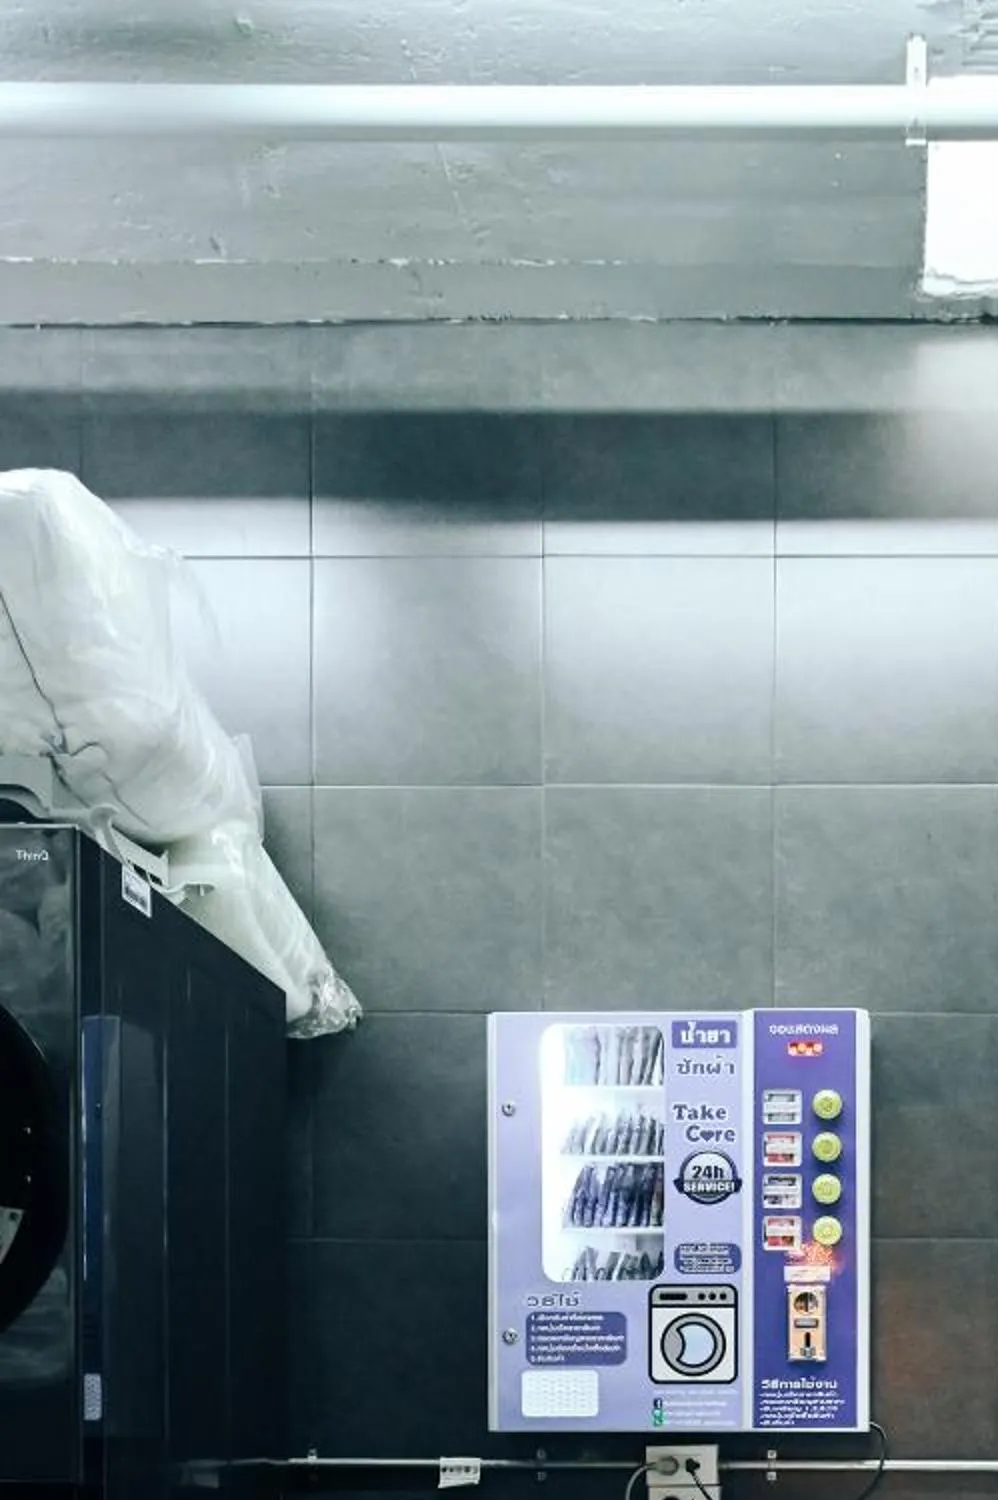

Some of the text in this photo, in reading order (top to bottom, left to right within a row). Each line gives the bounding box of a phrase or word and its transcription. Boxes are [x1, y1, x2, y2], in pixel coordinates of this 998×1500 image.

[681, 1021, 731, 1044] น้ำยา
[676, 1055, 735, 1075] ซักผ้า
[673, 1103, 727, 1120] Take
[691, 1165, 725, 1179] 24h
